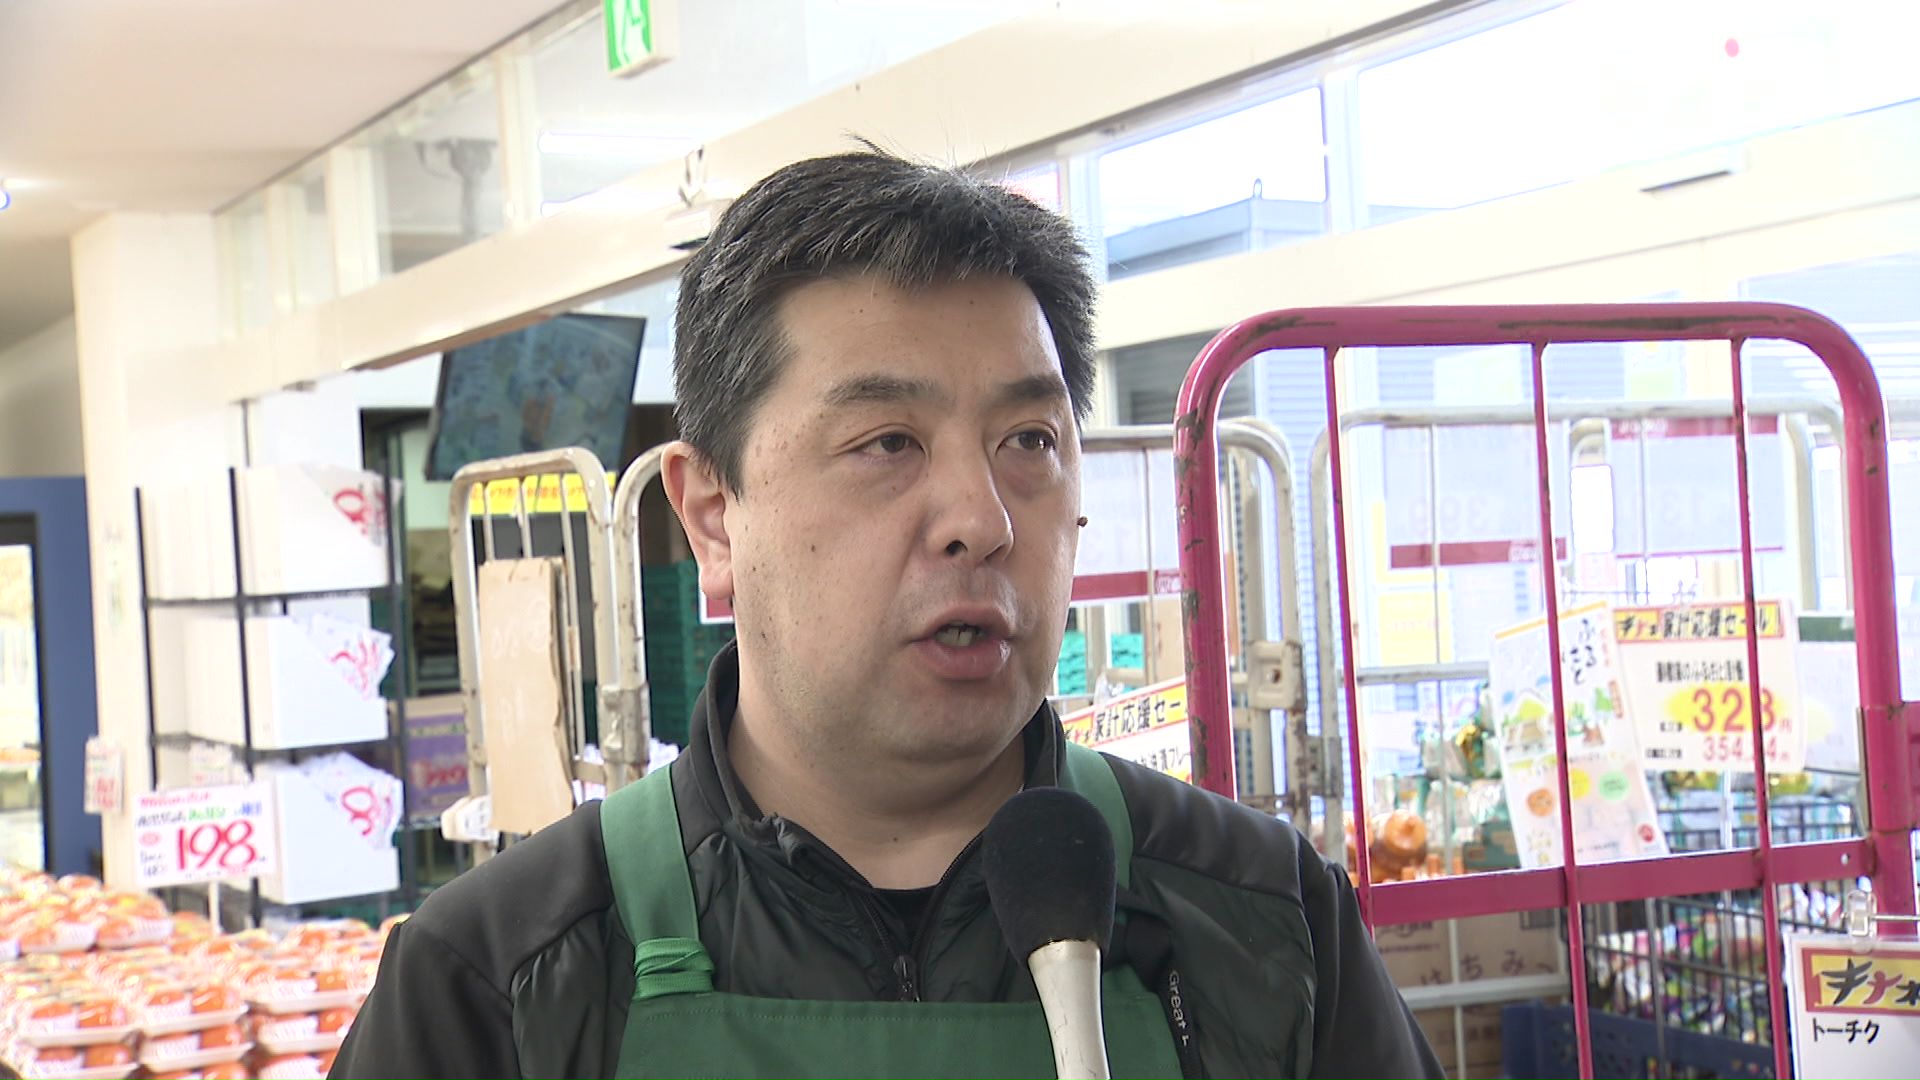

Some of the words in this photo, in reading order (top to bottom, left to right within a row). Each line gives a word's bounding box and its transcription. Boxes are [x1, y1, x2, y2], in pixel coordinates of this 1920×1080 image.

[1095, 695, 1188, 742] 家計応援セー
[176, 818, 257, 871] 198
[1168, 968, 1188, 1030] Great
[1811, 1016, 1882, 1045] トーチク
